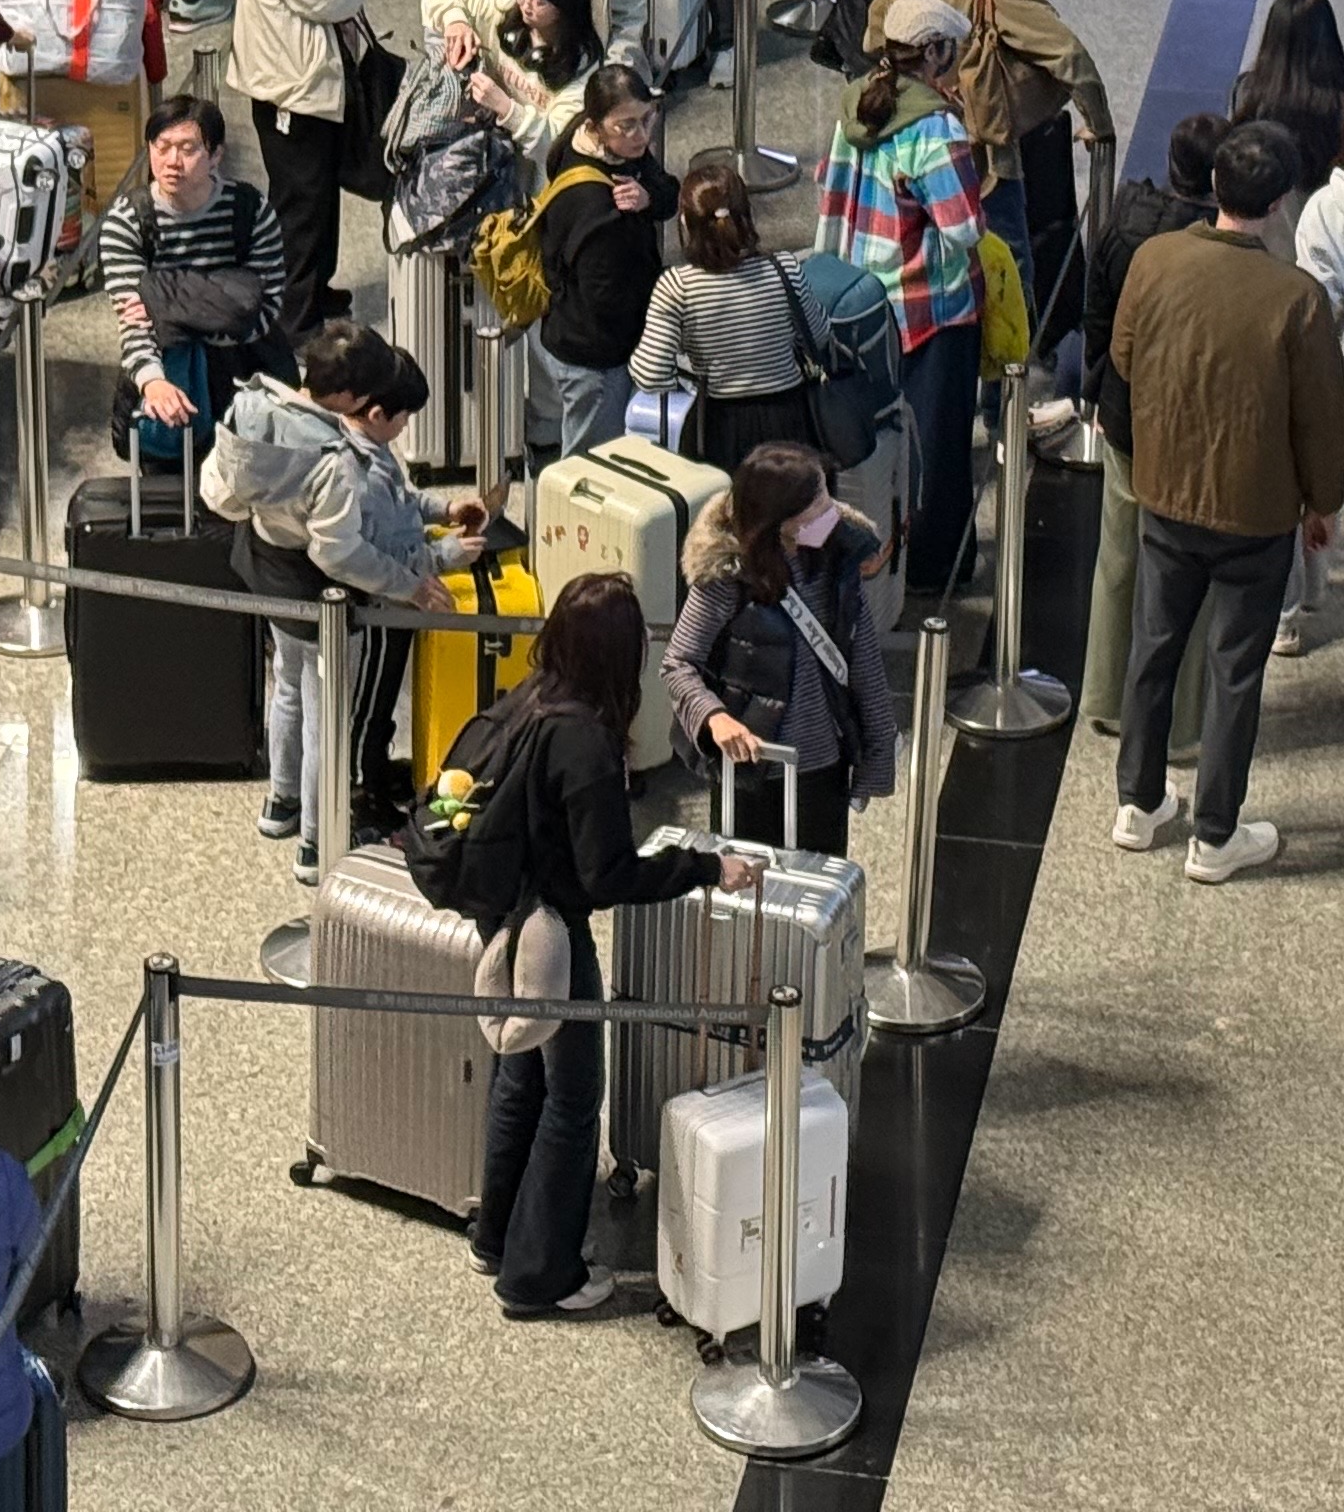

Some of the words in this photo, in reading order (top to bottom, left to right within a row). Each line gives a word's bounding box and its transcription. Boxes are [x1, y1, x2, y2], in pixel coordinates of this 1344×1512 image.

[492, 1001, 541, 1015] Taiwan
[543, 1002, 603, 1020] Taoyuan
[605, 1005, 696, 1021] International
[698, 1007, 749, 1023] Airport
